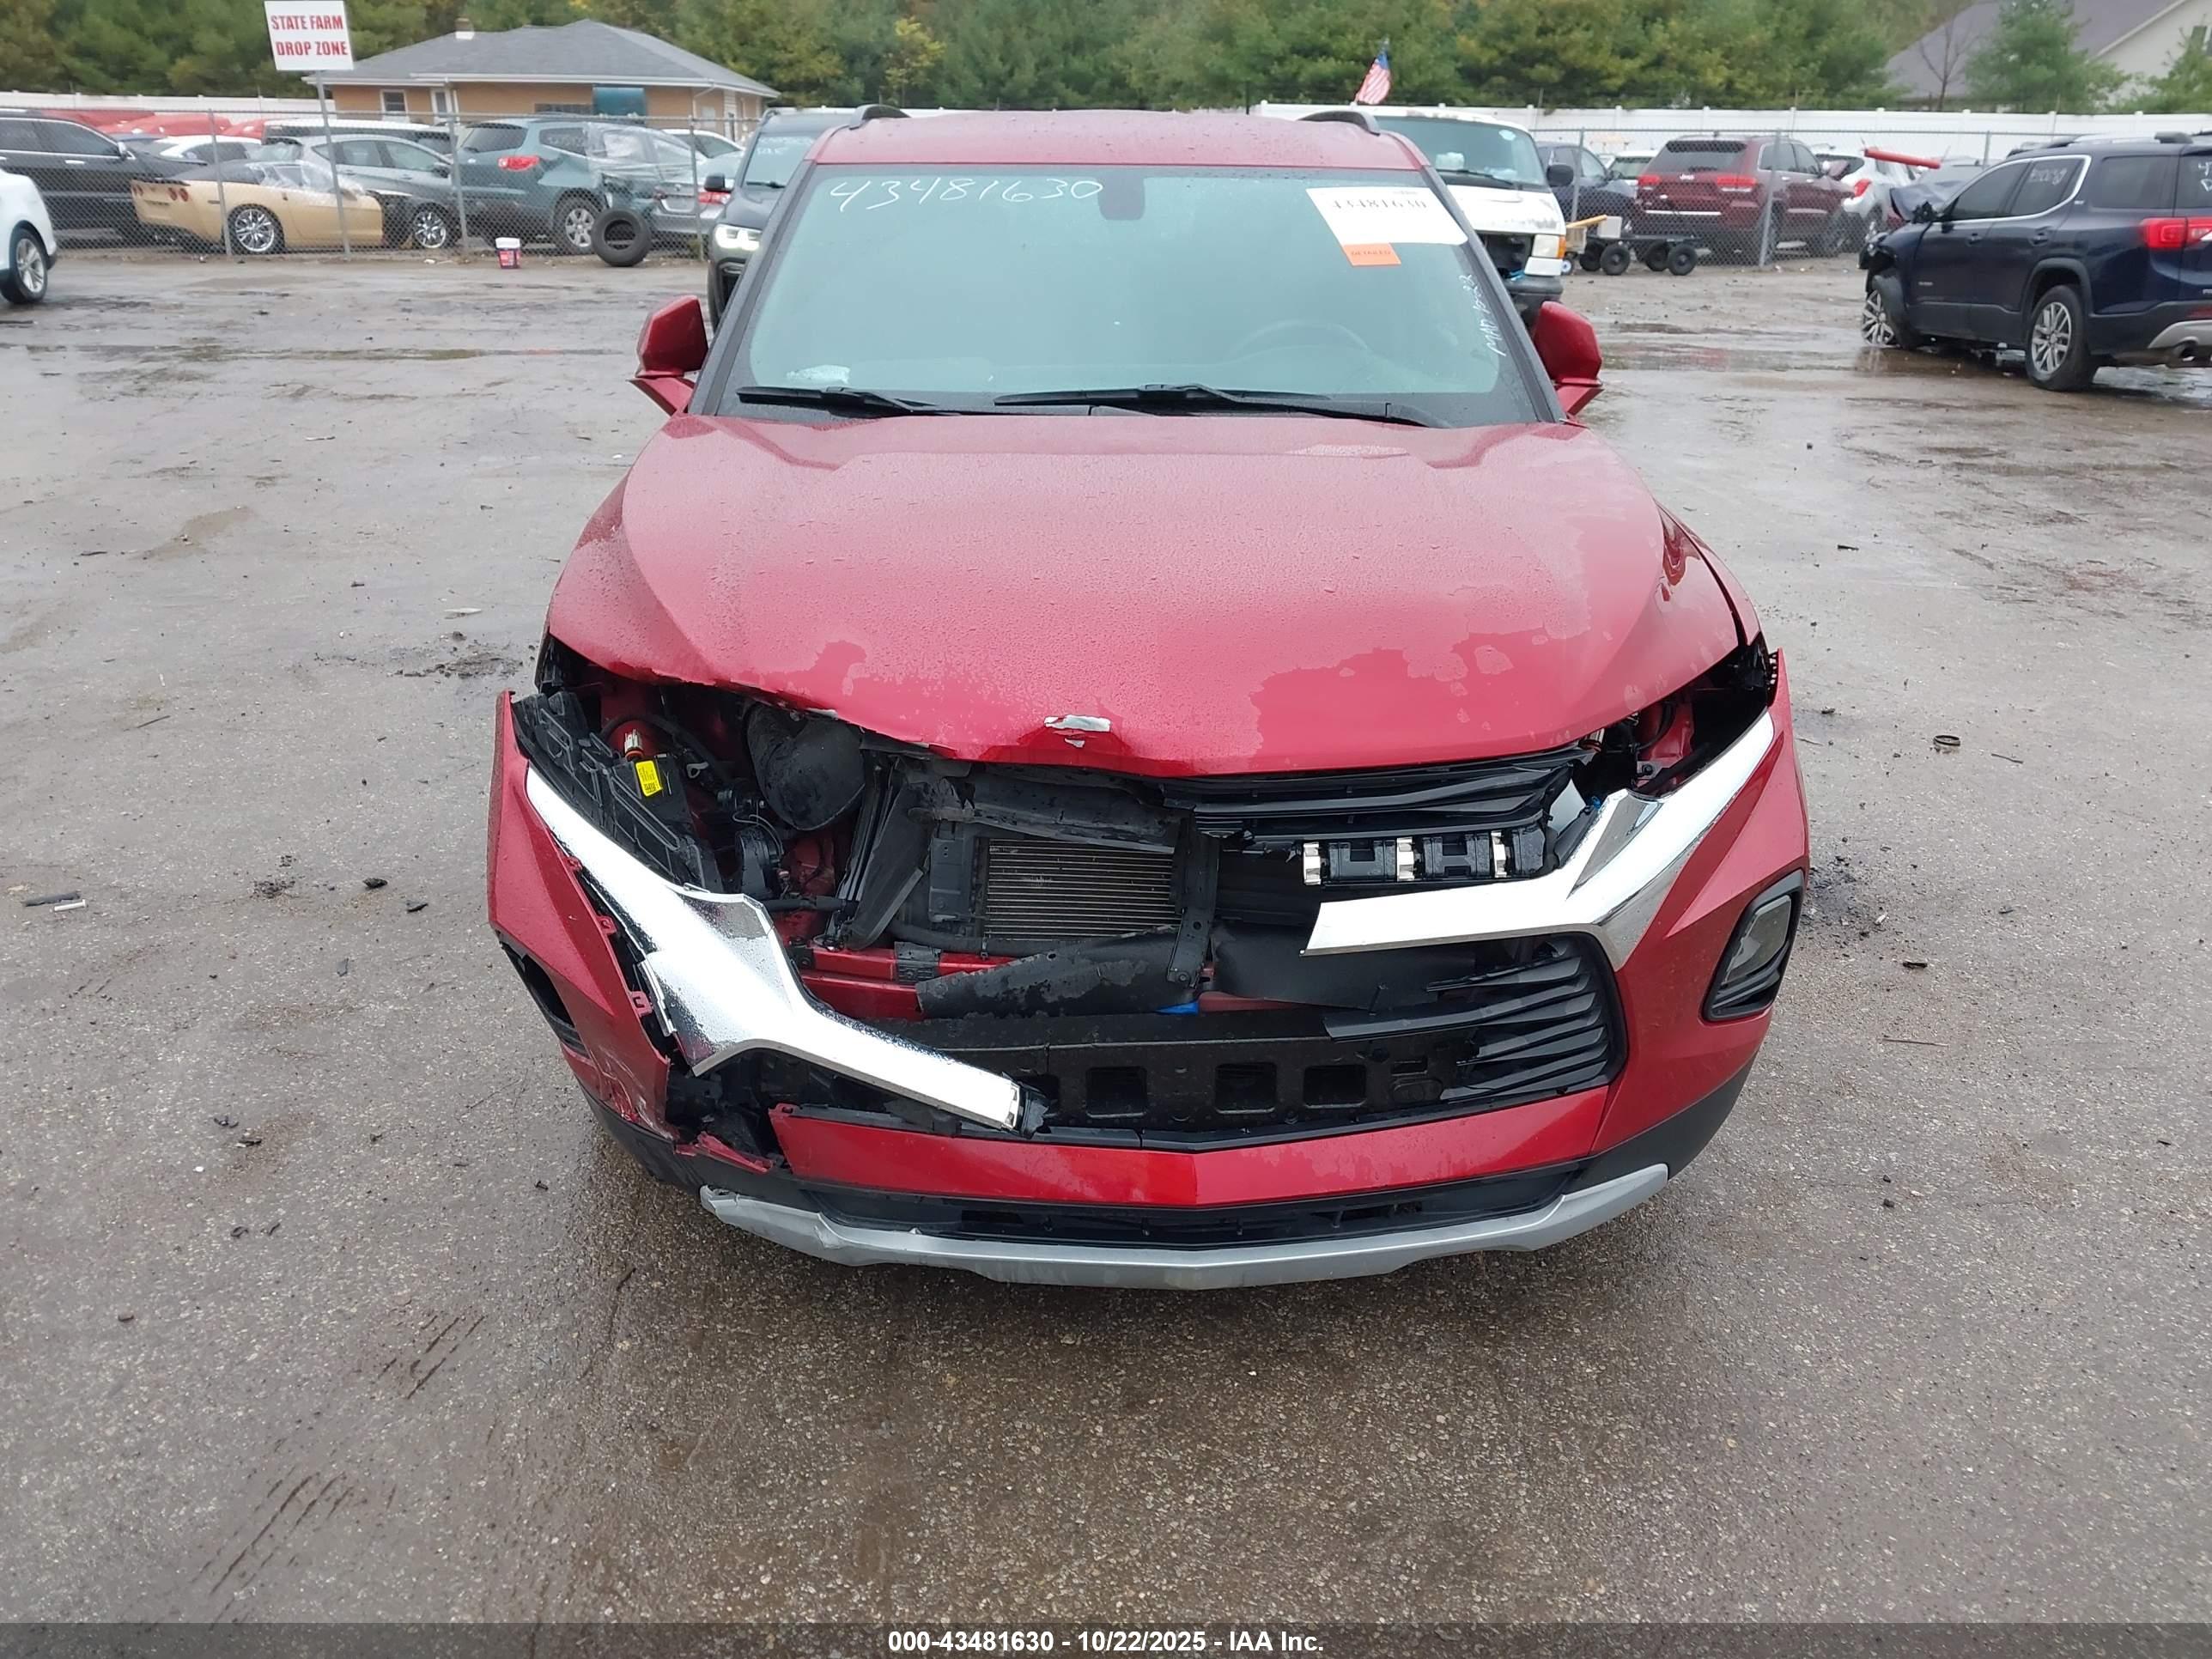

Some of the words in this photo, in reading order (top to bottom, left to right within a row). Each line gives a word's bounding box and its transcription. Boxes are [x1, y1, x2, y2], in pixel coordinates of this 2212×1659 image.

[270, 15, 308, 30] STATE
[309, 15, 344, 30] FARM
[275, 40, 312, 56] DROP
[314, 40, 349, 56] ZONE
[830, 177, 1103, 212] 43481630
